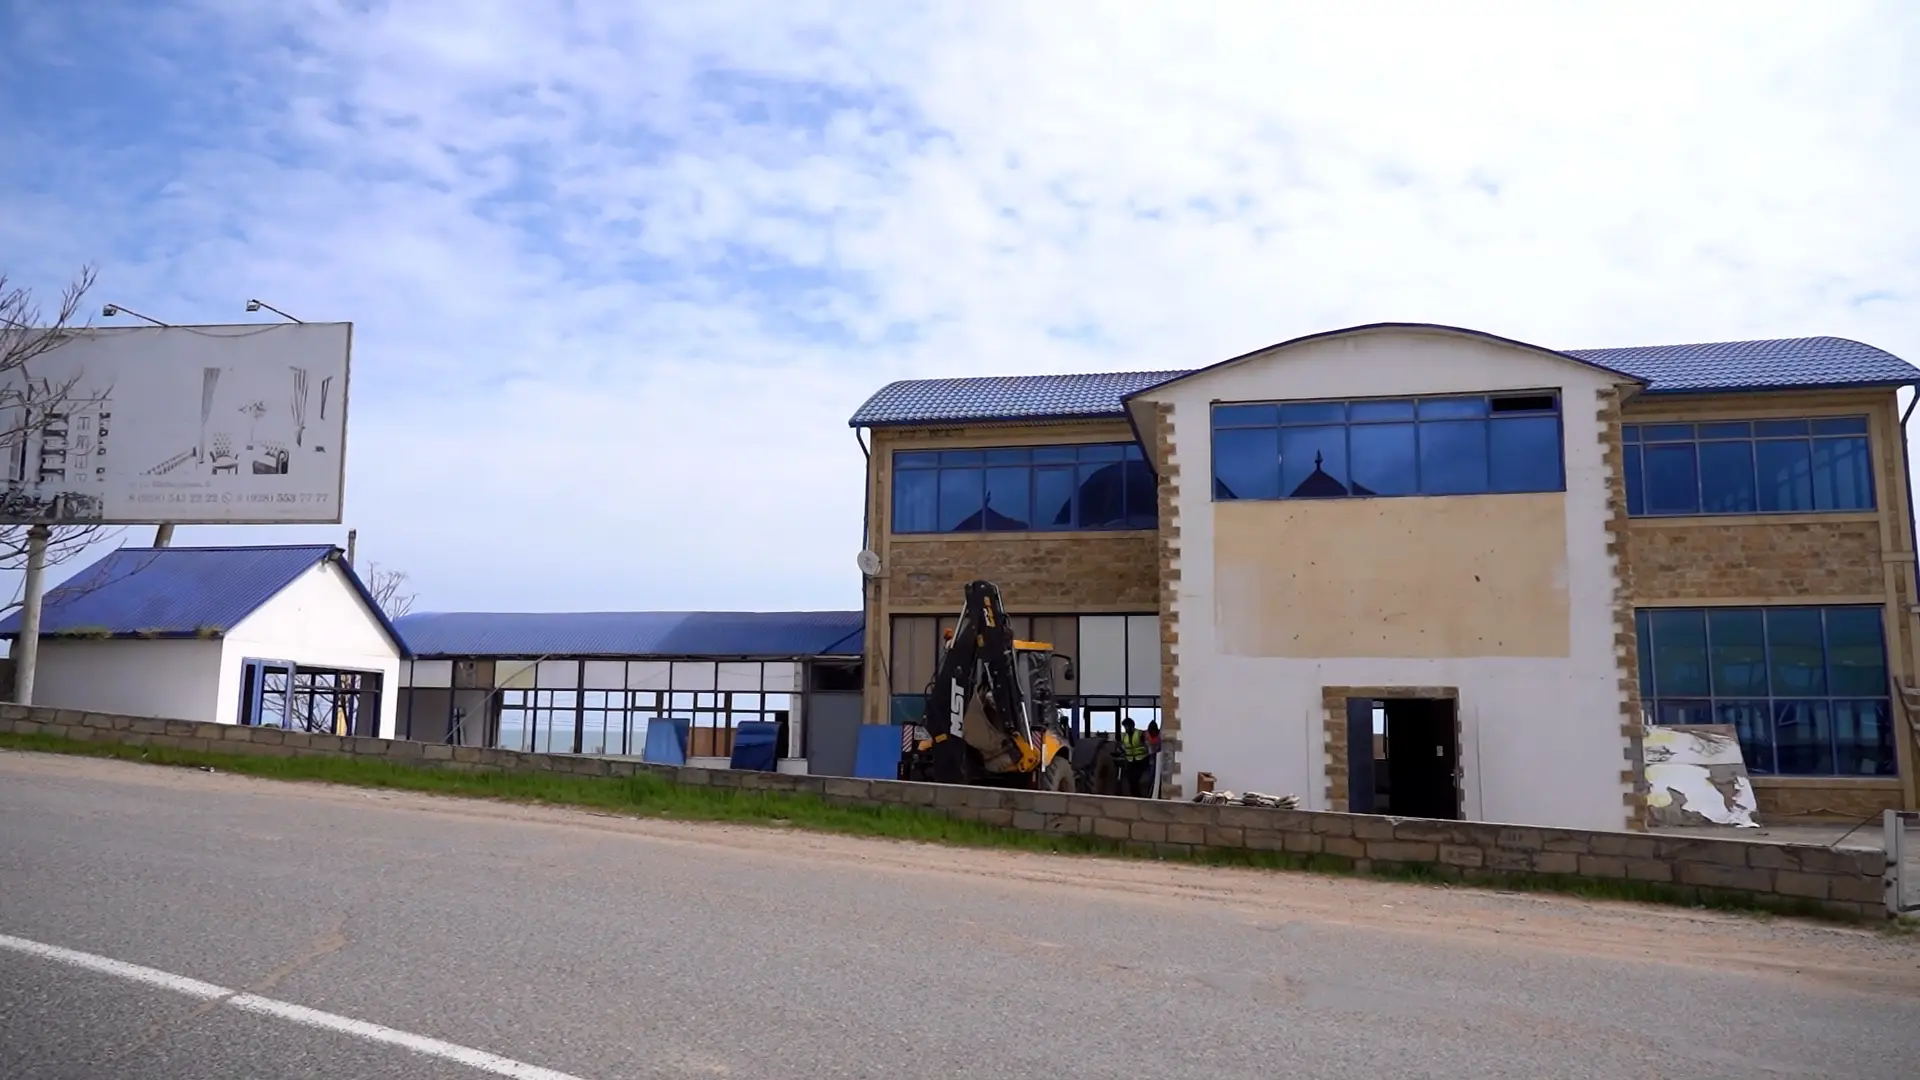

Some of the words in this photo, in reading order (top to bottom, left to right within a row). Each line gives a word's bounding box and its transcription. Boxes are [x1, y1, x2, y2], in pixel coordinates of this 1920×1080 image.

[204, 493, 218, 503] 22
[276, 493, 296, 503] 553
[299, 493, 312, 503] 77
[315, 493, 329, 503] 77
[949, 677, 965, 739] MST
